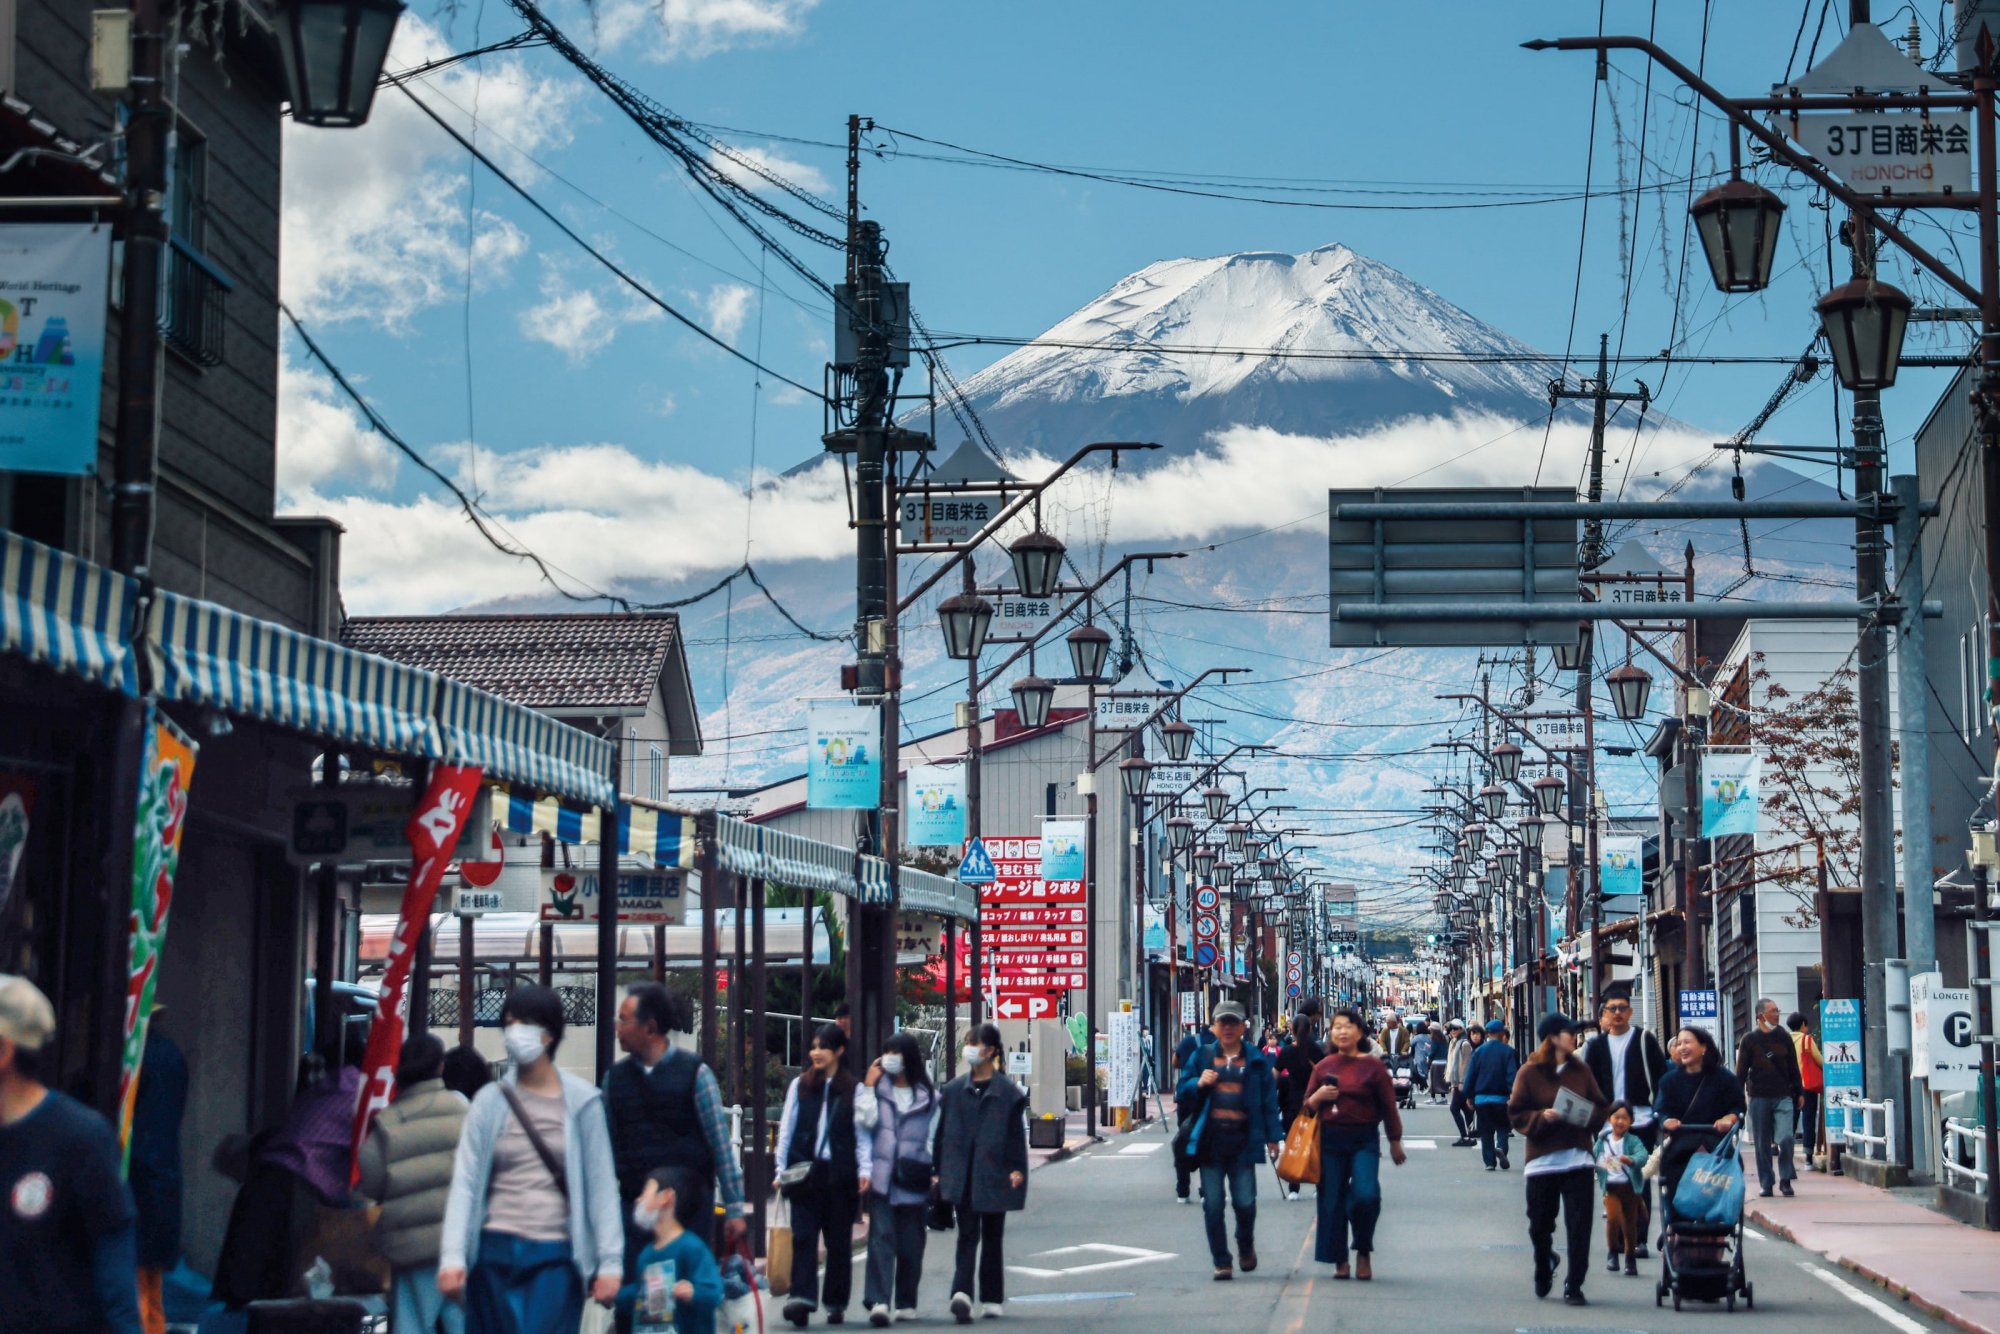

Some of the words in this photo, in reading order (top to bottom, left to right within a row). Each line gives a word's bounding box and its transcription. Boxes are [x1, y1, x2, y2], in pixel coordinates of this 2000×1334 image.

[1827, 124, 1968, 156] 3丁目商栄会
[1852, 164, 1933, 180] HONCHO
[906, 502, 989, 522] 3丁目商栄会
[993, 601, 1050, 617] 丁目商栄会
[1100, 702, 1150, 714] 3丁目商栄会
[1536, 723, 1583, 734] 3丁目商栄会
[581, 873, 681, 898] 小田園芸店
[981, 880, 1047, 897] ッケージ館
[1049, 881, 1081, 895] クボタ
[1200, 893, 1215, 904] 40
[1044, 911, 1066, 921] ラップ
[981, 955, 1009, 965] 洋子箱
[1933, 993, 1970, 1001] LONGTE
[1029, 997, 1049, 1018] P
[1954, 1016, 1972, 1043] P
